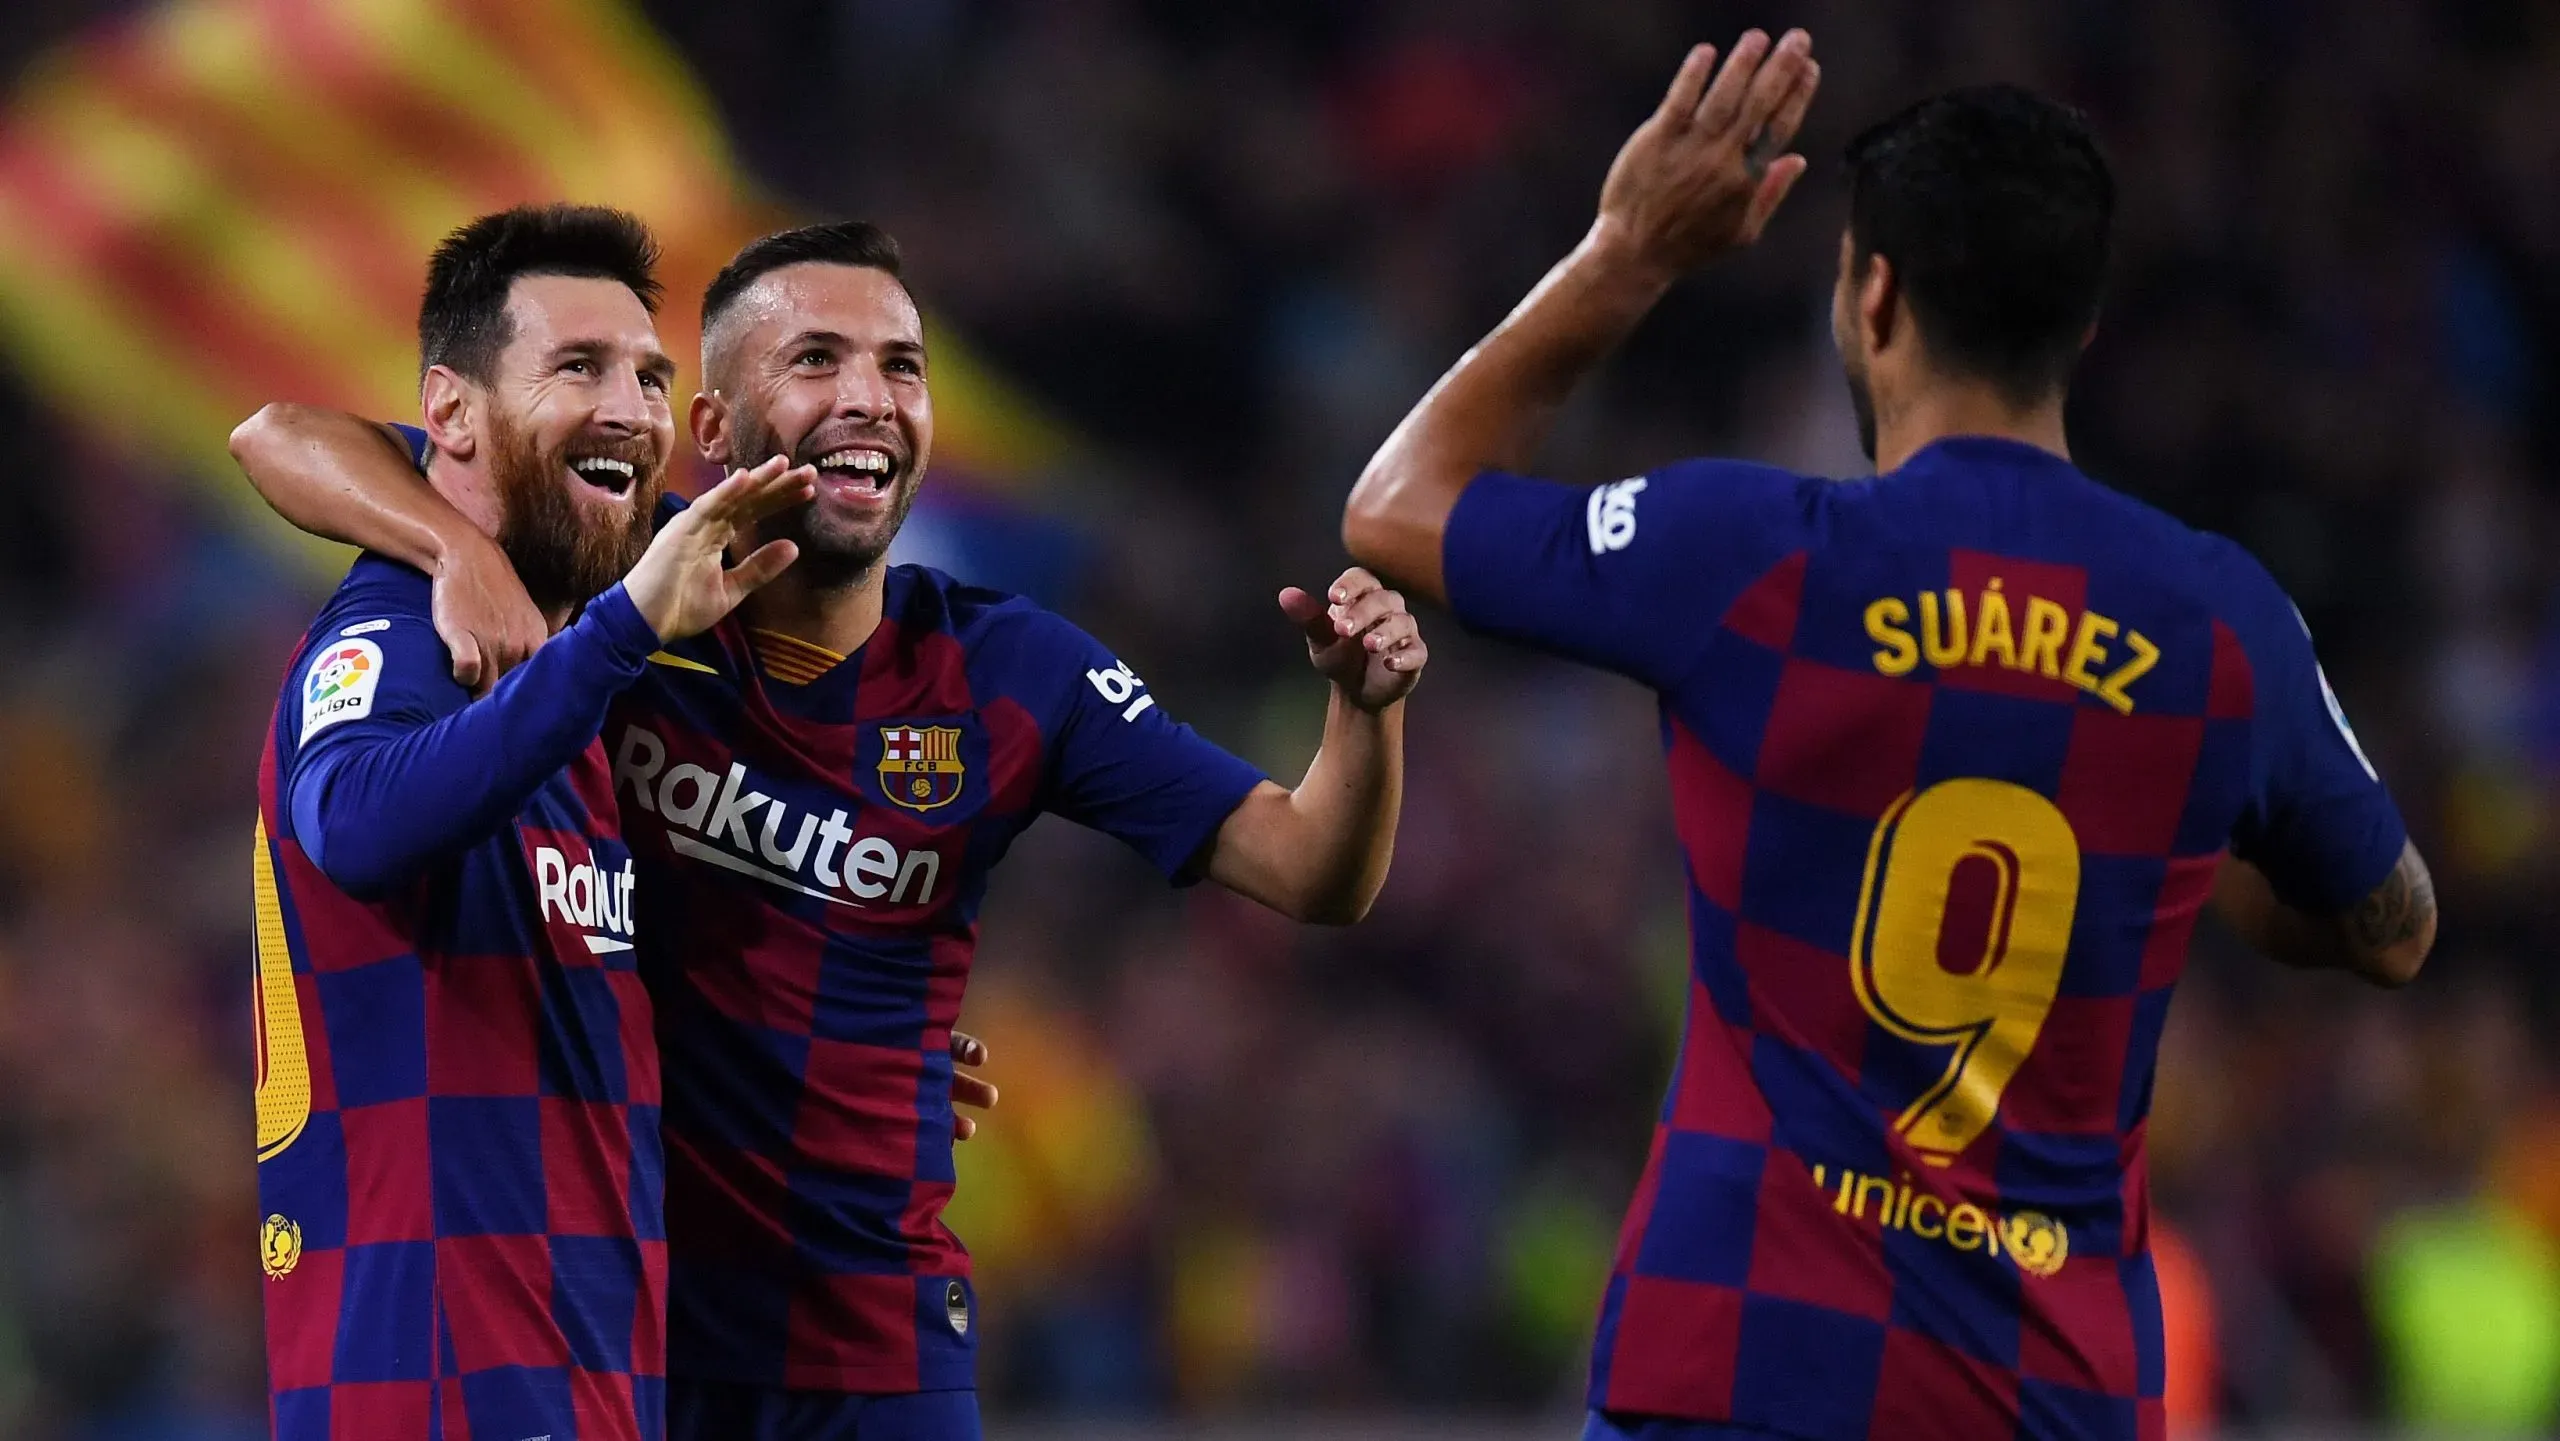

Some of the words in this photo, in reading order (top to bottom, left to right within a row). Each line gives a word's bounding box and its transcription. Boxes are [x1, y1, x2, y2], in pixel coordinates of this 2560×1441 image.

[1863, 576, 2161, 716] SUÁREZ
[614, 724, 940, 905] Rakuten
[904, 761, 937, 772] FCB
[1849, 777, 2081, 1167] 9
